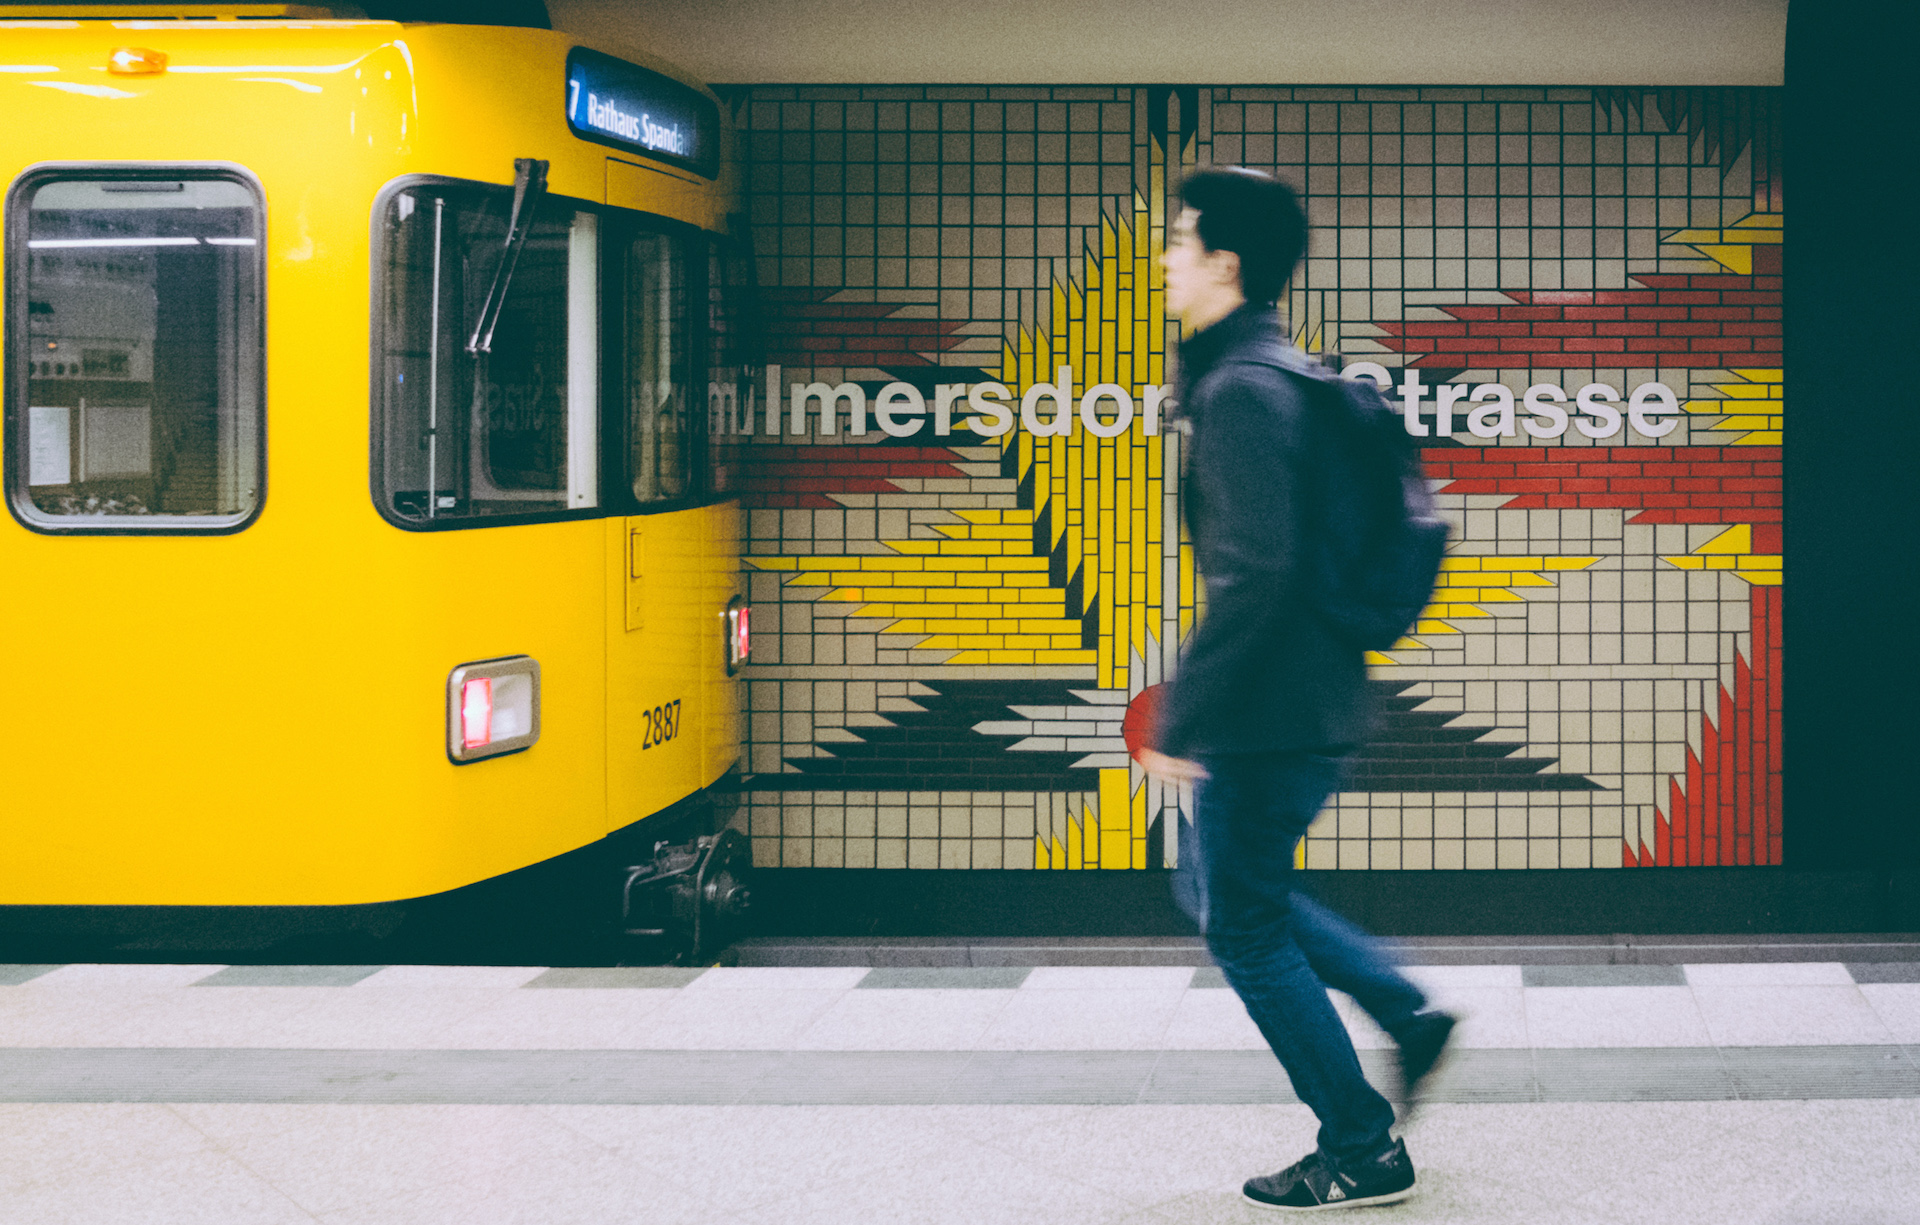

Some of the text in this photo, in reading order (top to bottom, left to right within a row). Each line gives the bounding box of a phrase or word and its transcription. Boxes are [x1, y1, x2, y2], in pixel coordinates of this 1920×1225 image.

[569, 79, 689, 156] 7 Rathaus Spanda
[642, 698, 681, 750] 2887
